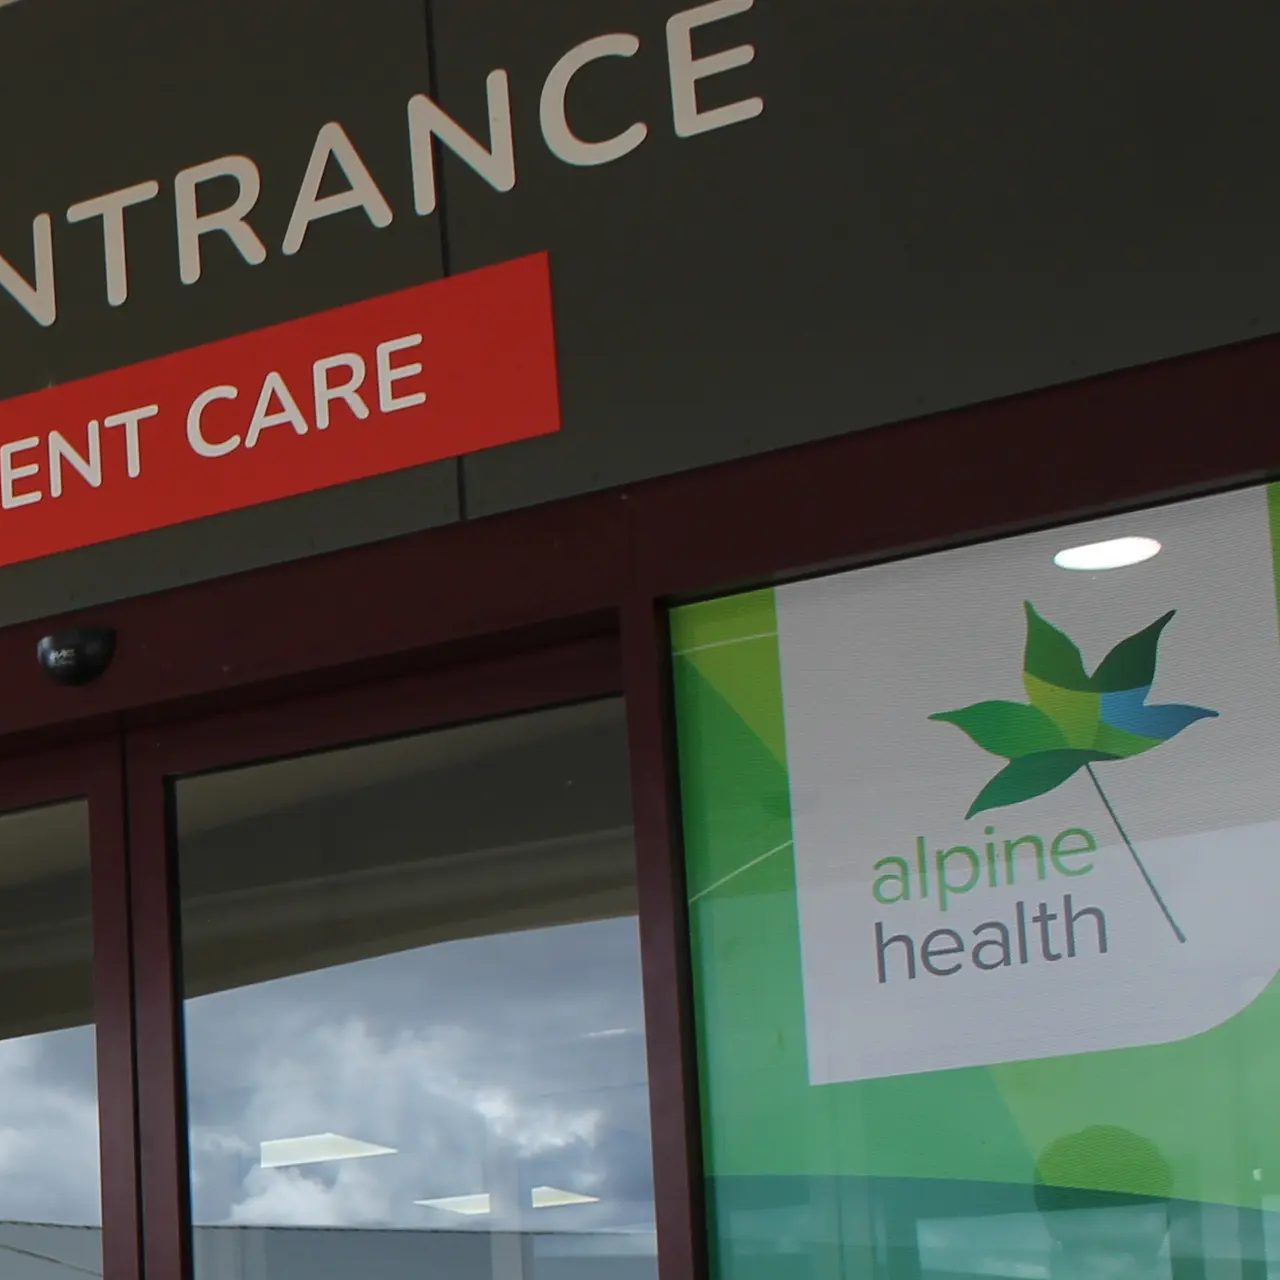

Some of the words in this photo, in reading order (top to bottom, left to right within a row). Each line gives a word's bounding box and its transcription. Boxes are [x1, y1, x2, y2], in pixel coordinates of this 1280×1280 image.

[185, 333, 429, 458] CARE
[871, 824, 1098, 912] alpine
[874, 893, 1109, 984] health
